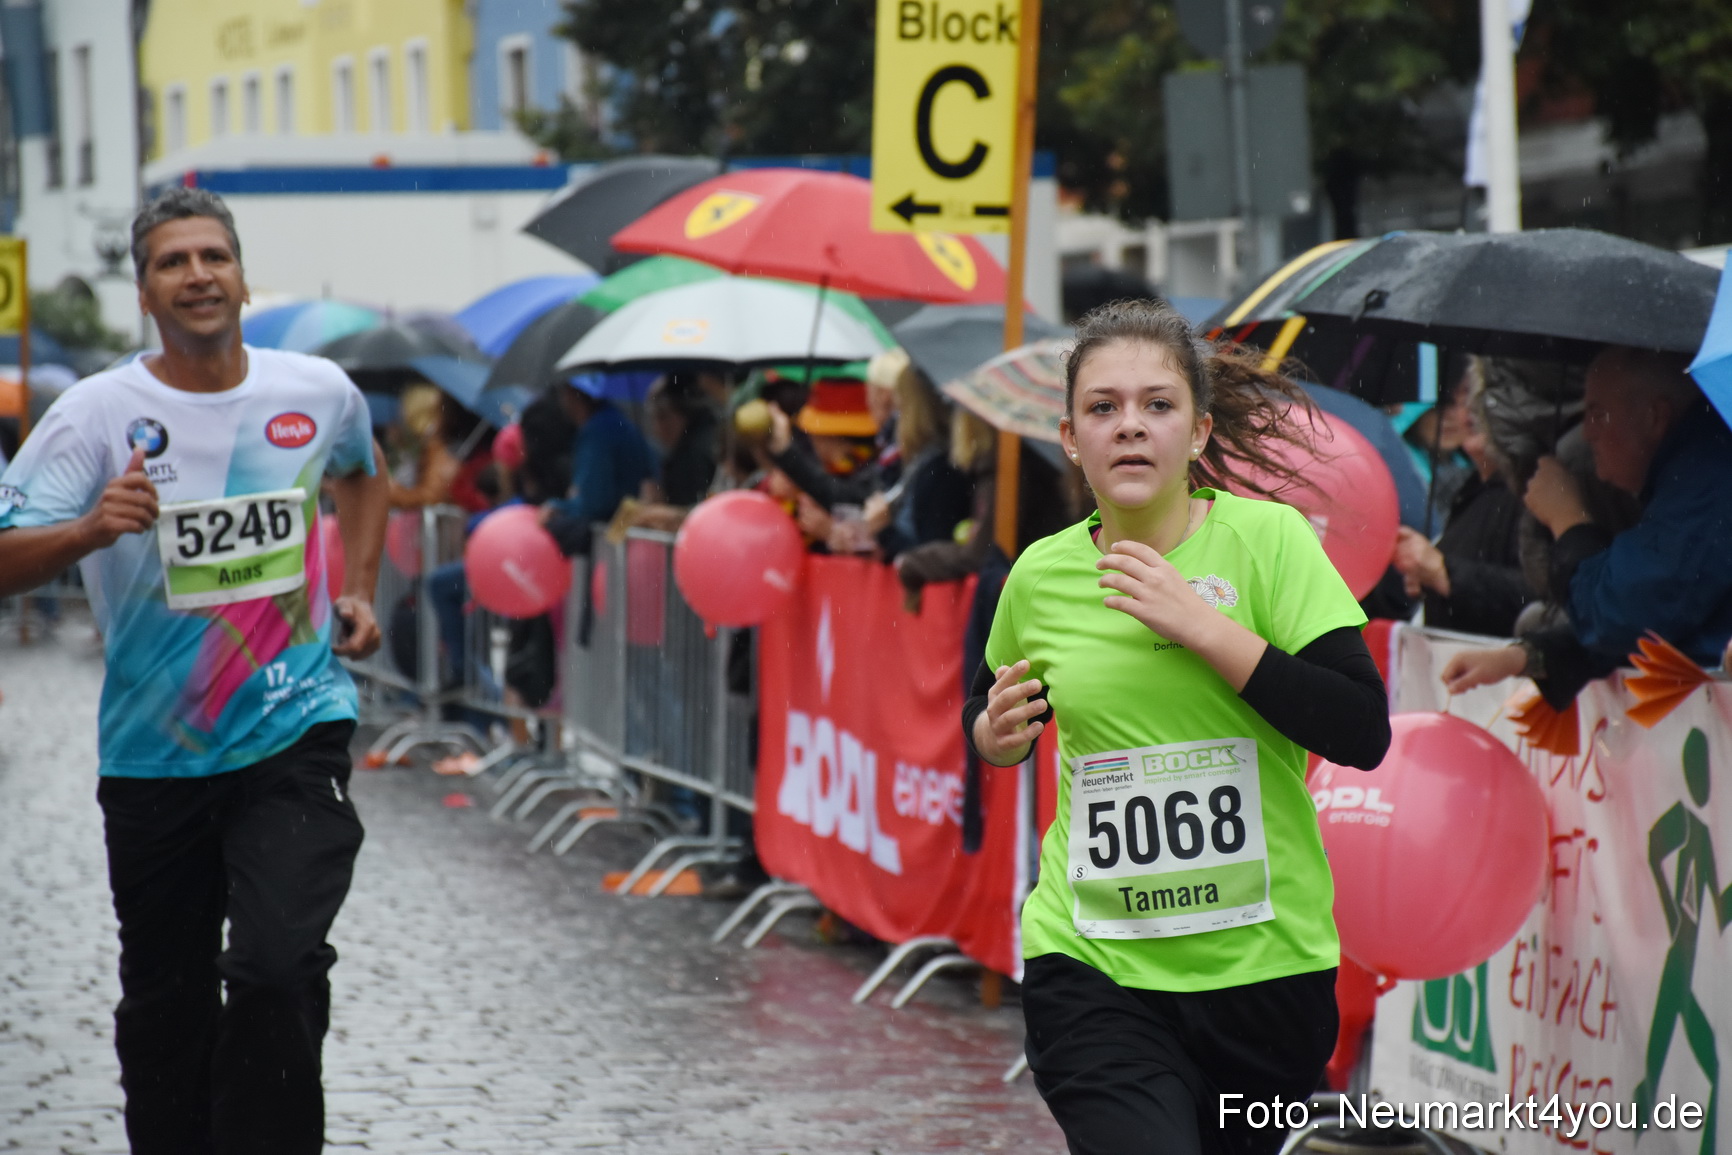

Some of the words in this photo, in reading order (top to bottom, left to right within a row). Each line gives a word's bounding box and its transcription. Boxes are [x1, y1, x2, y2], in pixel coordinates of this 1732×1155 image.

[898, 1, 1018, 43] Block
[916, 64, 991, 179] C
[176, 500, 292, 559] 5246
[219, 564, 263, 585] Anas
[265, 661, 294, 687] 17.
[1142, 745, 1239, 776] BOCK
[1081, 772, 1134, 787] NeuerMarkt
[1144, 775, 1172, 785] inspired
[1173, 773, 1182, 782] by
[1183, 771, 1207, 781] smart
[1208, 767, 1241, 778] concepts
[1088, 785, 1246, 869] 5068
[1118, 882, 1219, 912] Tamara
